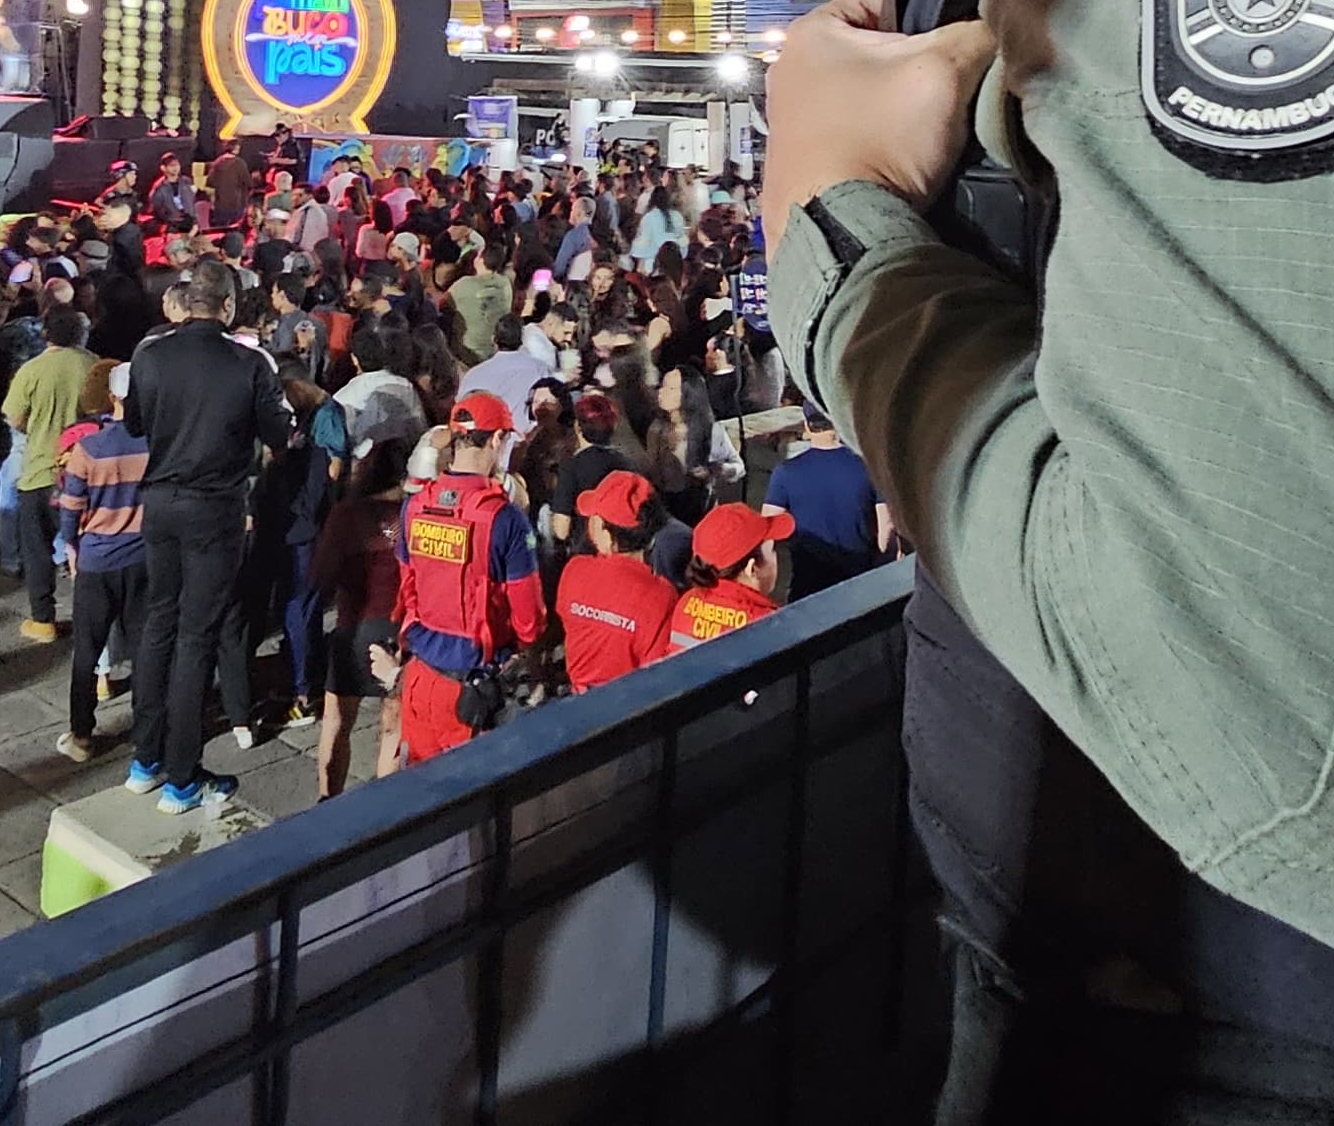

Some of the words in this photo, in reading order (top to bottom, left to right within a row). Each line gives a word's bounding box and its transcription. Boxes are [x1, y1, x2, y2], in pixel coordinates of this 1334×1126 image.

[412, 522, 464, 546] BOMBEIRO
[419, 537, 455, 558] CIVIL
[683, 596, 747, 629] BOMBEIRO
